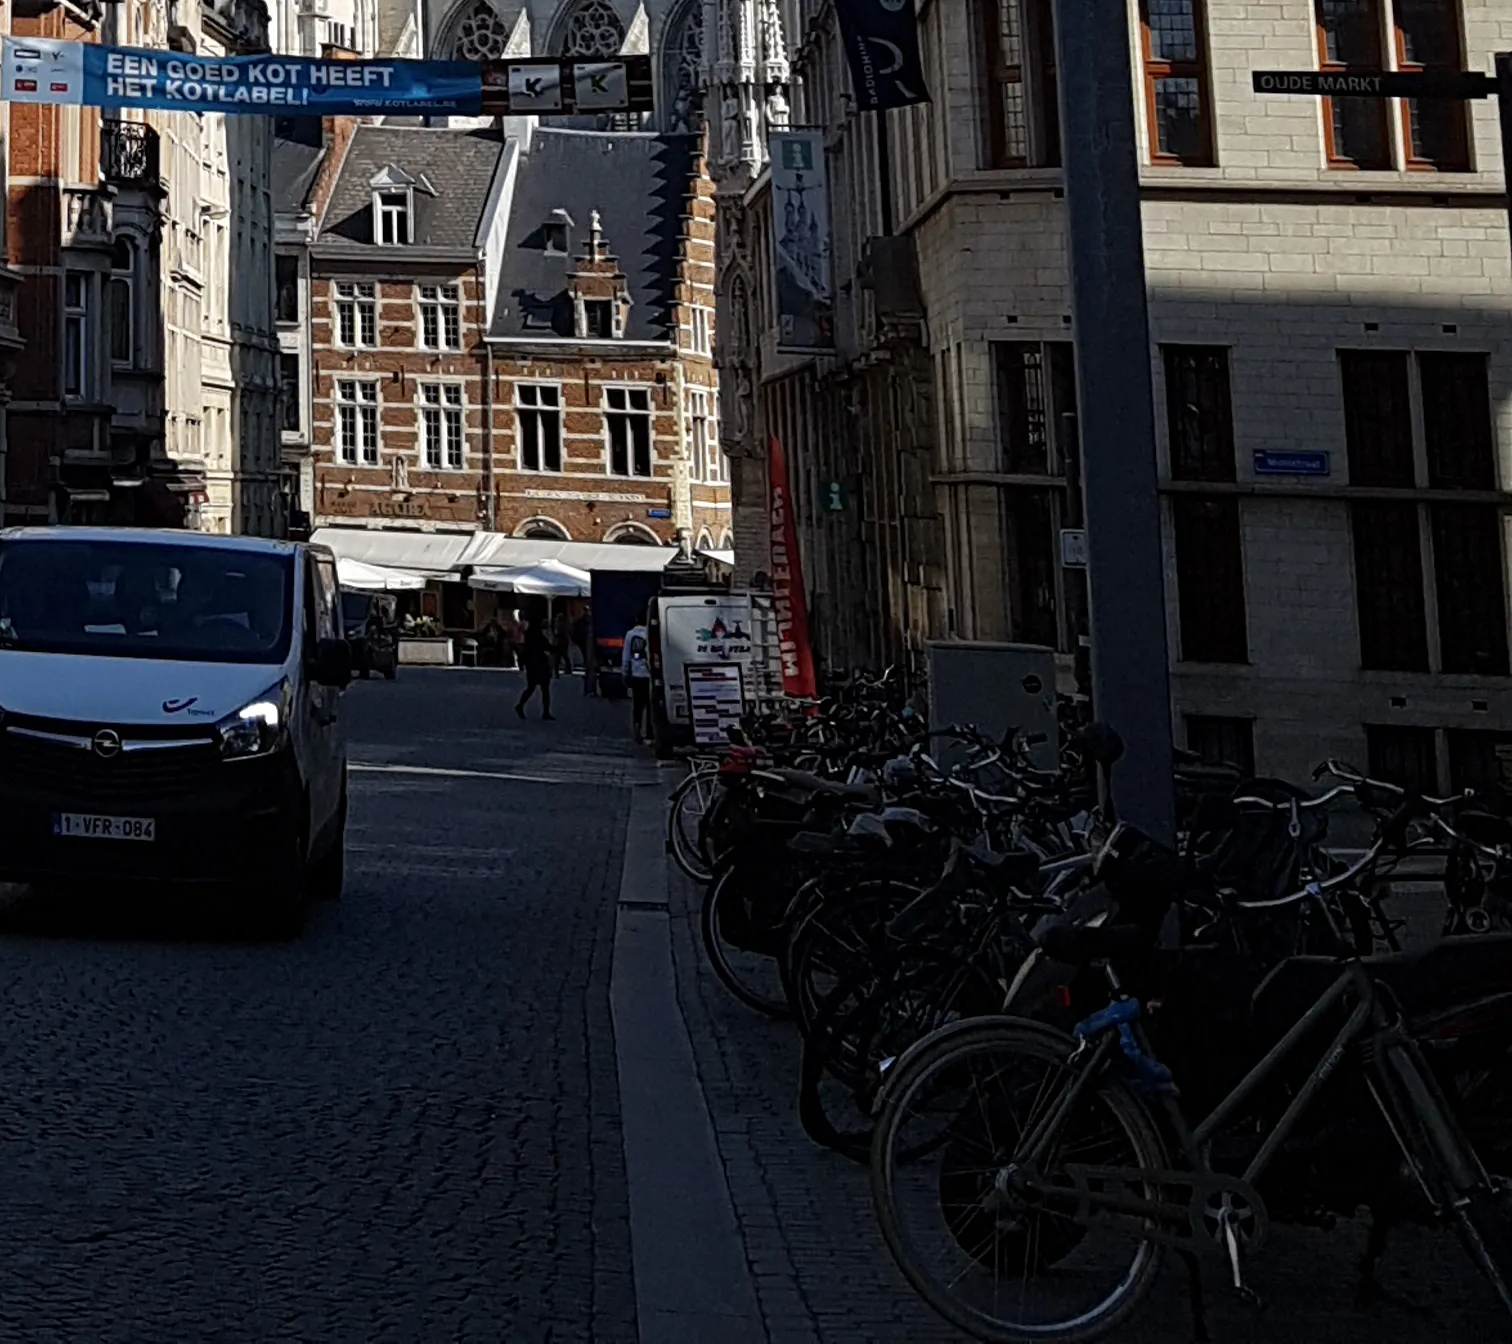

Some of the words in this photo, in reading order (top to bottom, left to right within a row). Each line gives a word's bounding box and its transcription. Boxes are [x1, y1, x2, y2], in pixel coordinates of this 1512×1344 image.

[106, 53, 158, 77] EEN
[166, 59, 239, 83] GOED
[248, 63, 302, 85] KOT
[309, 65, 394, 88] HEEFT
[1260, 75, 1313, 90] OUDE
[1318, 76, 1381, 92] MARKT
[106, 78, 156, 98] HET
[165, 80, 309, 106] KOTLABEL!
